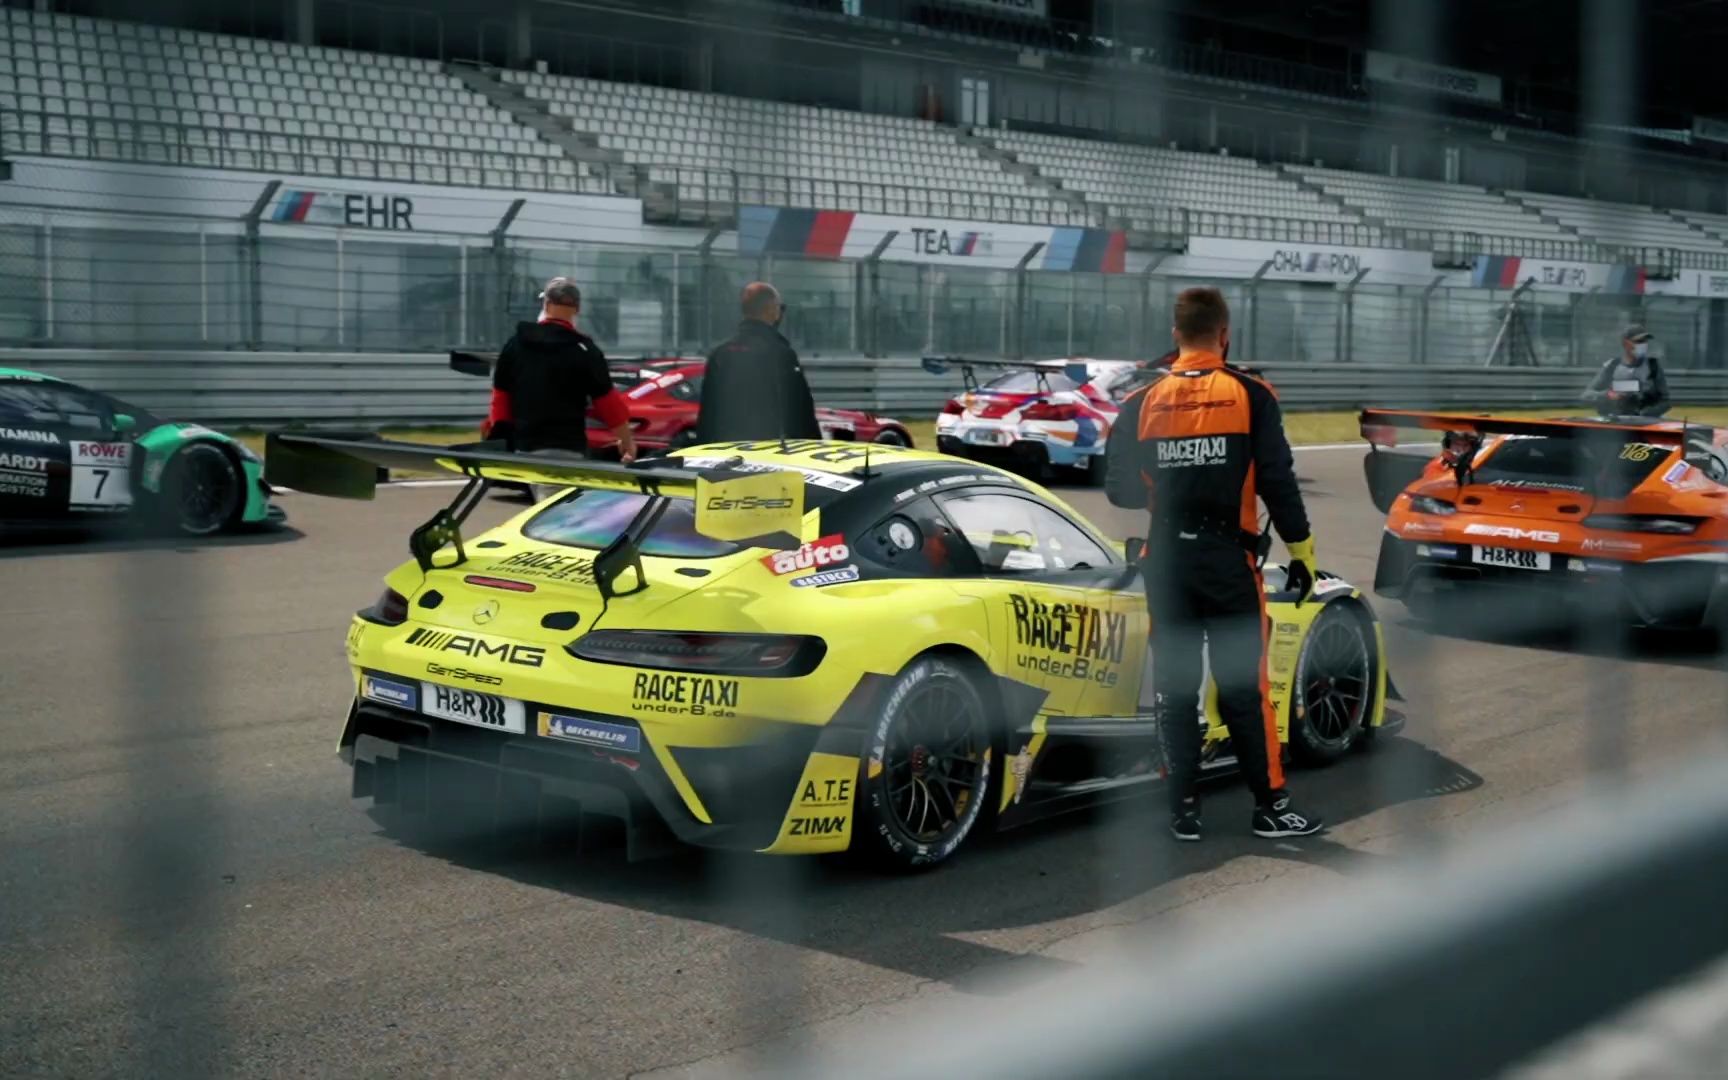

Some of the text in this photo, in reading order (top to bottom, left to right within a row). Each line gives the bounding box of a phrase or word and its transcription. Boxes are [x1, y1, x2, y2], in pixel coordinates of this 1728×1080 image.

[79, 444, 127, 458] ROWE
[1157, 436, 1227, 460] RACETAXI
[1619, 443, 1650, 461] 16
[92, 469, 110, 499] 7
[1494, 527, 1561, 544] AMG
[499, 551, 596, 578] RACETA
[773, 543, 849, 574] auto
[796, 569, 852, 586] BASTUCK
[1009, 593, 1127, 664] RACETAXI
[442, 634, 547, 668] AMG
[1016, 653, 1119, 686] under8.de
[435, 685, 477, 717] H&R
[633, 672, 740, 708] RACETAXI
[631, 702, 736, 719] under8.de
[565, 724, 628, 744] MICHELIN
